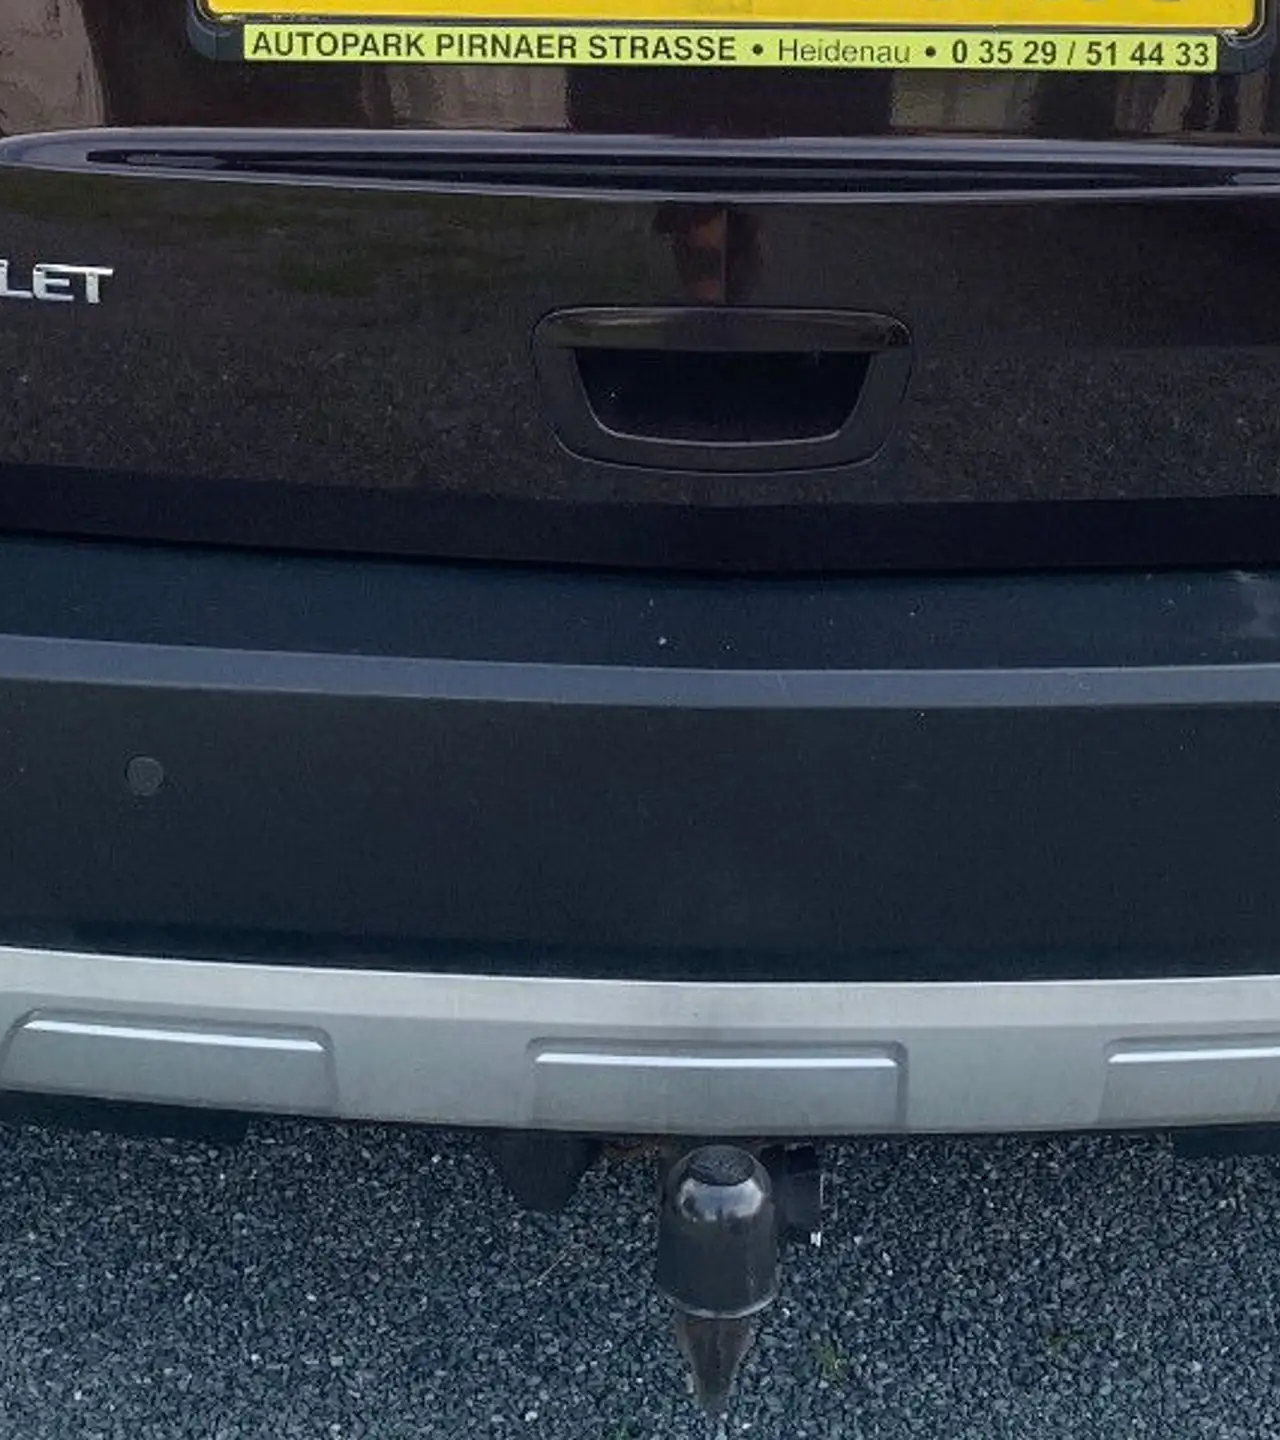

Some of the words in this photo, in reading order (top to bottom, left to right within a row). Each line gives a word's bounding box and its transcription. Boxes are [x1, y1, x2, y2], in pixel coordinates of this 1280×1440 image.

[251, 30, 426, 57] AUTOPARK
[435, 33, 579, 59] PIRNAER
[587, 35, 737, 61] STRASSE
[777, 37, 911, 64] Heidenau
[951, 40, 968, 64] 0
[977, 40, 1014, 65] 35
[1022, 40, 1058, 65] 29
[1085, 41, 1118, 66] 51
[1128, 42, 1165, 67] 44
[1174, 42, 1211, 68] 33
